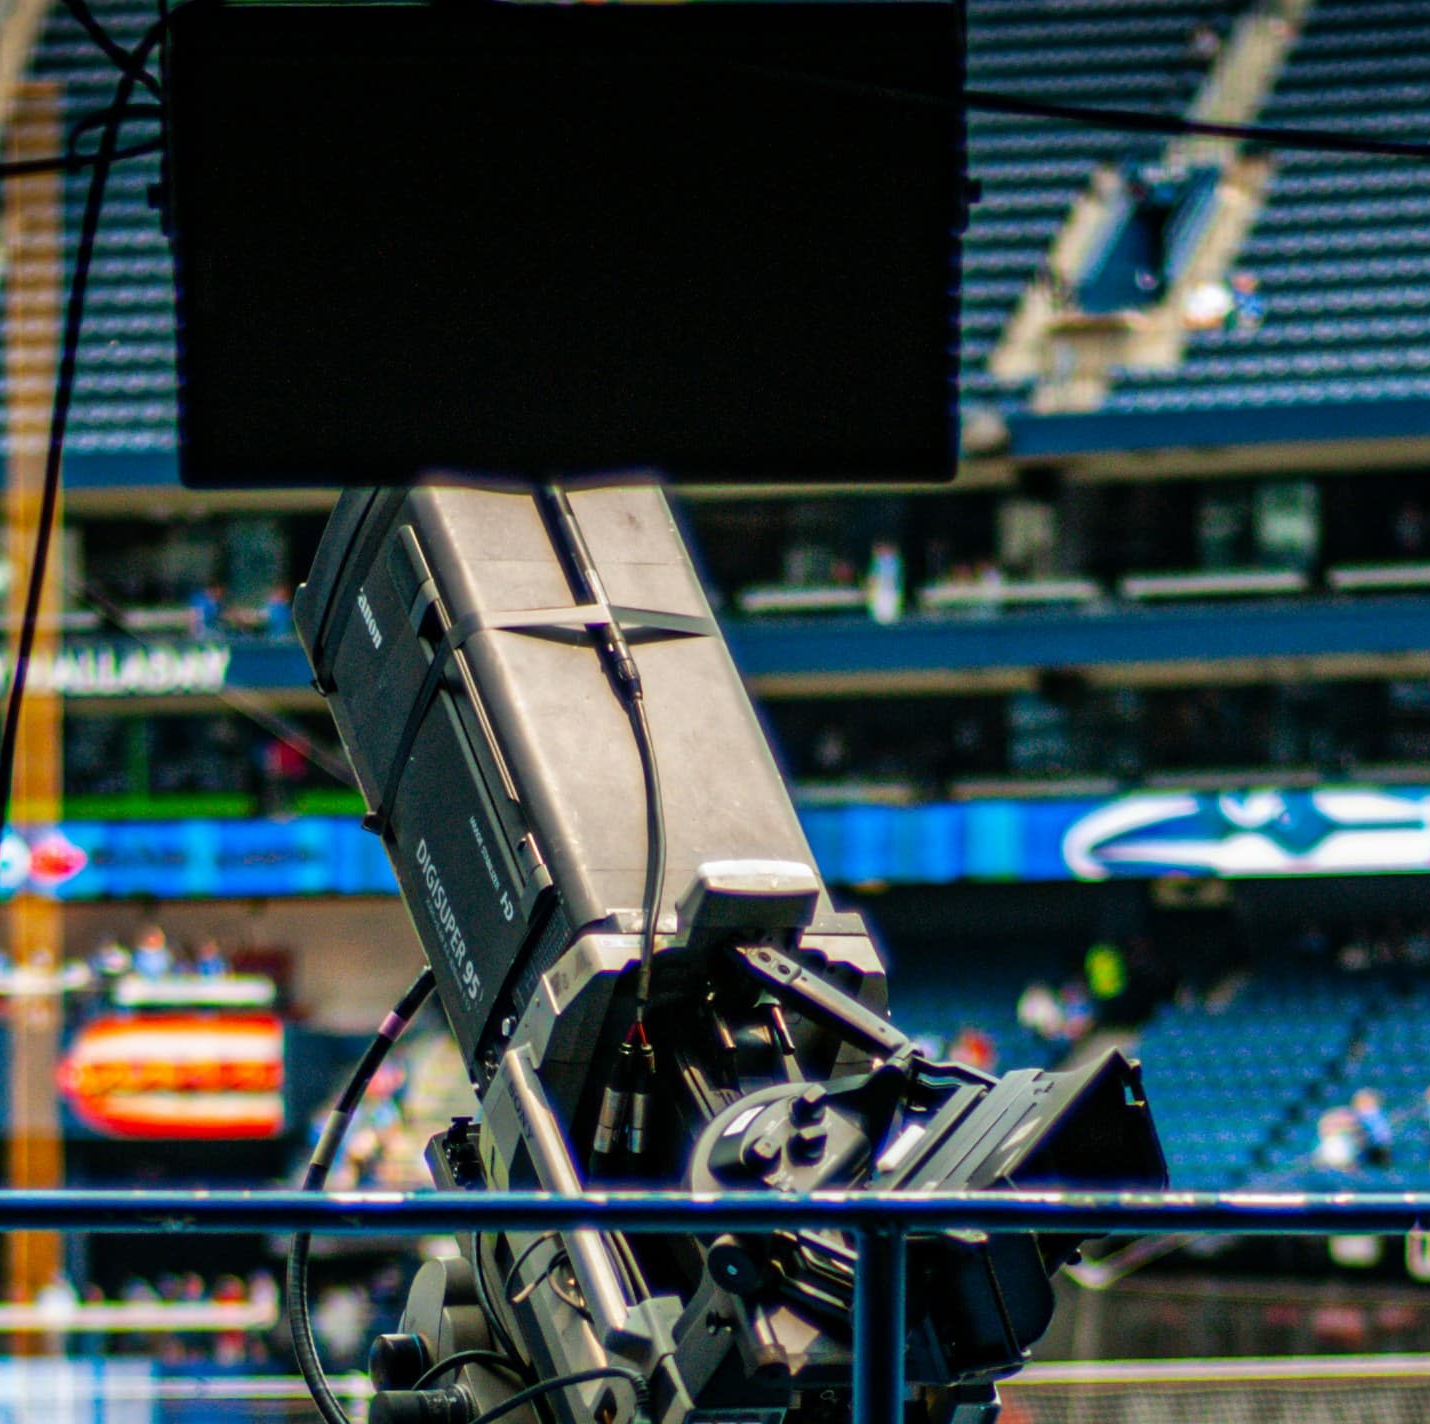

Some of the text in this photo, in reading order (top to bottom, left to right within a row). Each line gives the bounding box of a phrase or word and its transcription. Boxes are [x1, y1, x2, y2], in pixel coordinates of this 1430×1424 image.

[357, 586, 383, 650] anon
[416, 838, 466, 968] DIGISUPER
[462, 959, 481, 1000] 95
